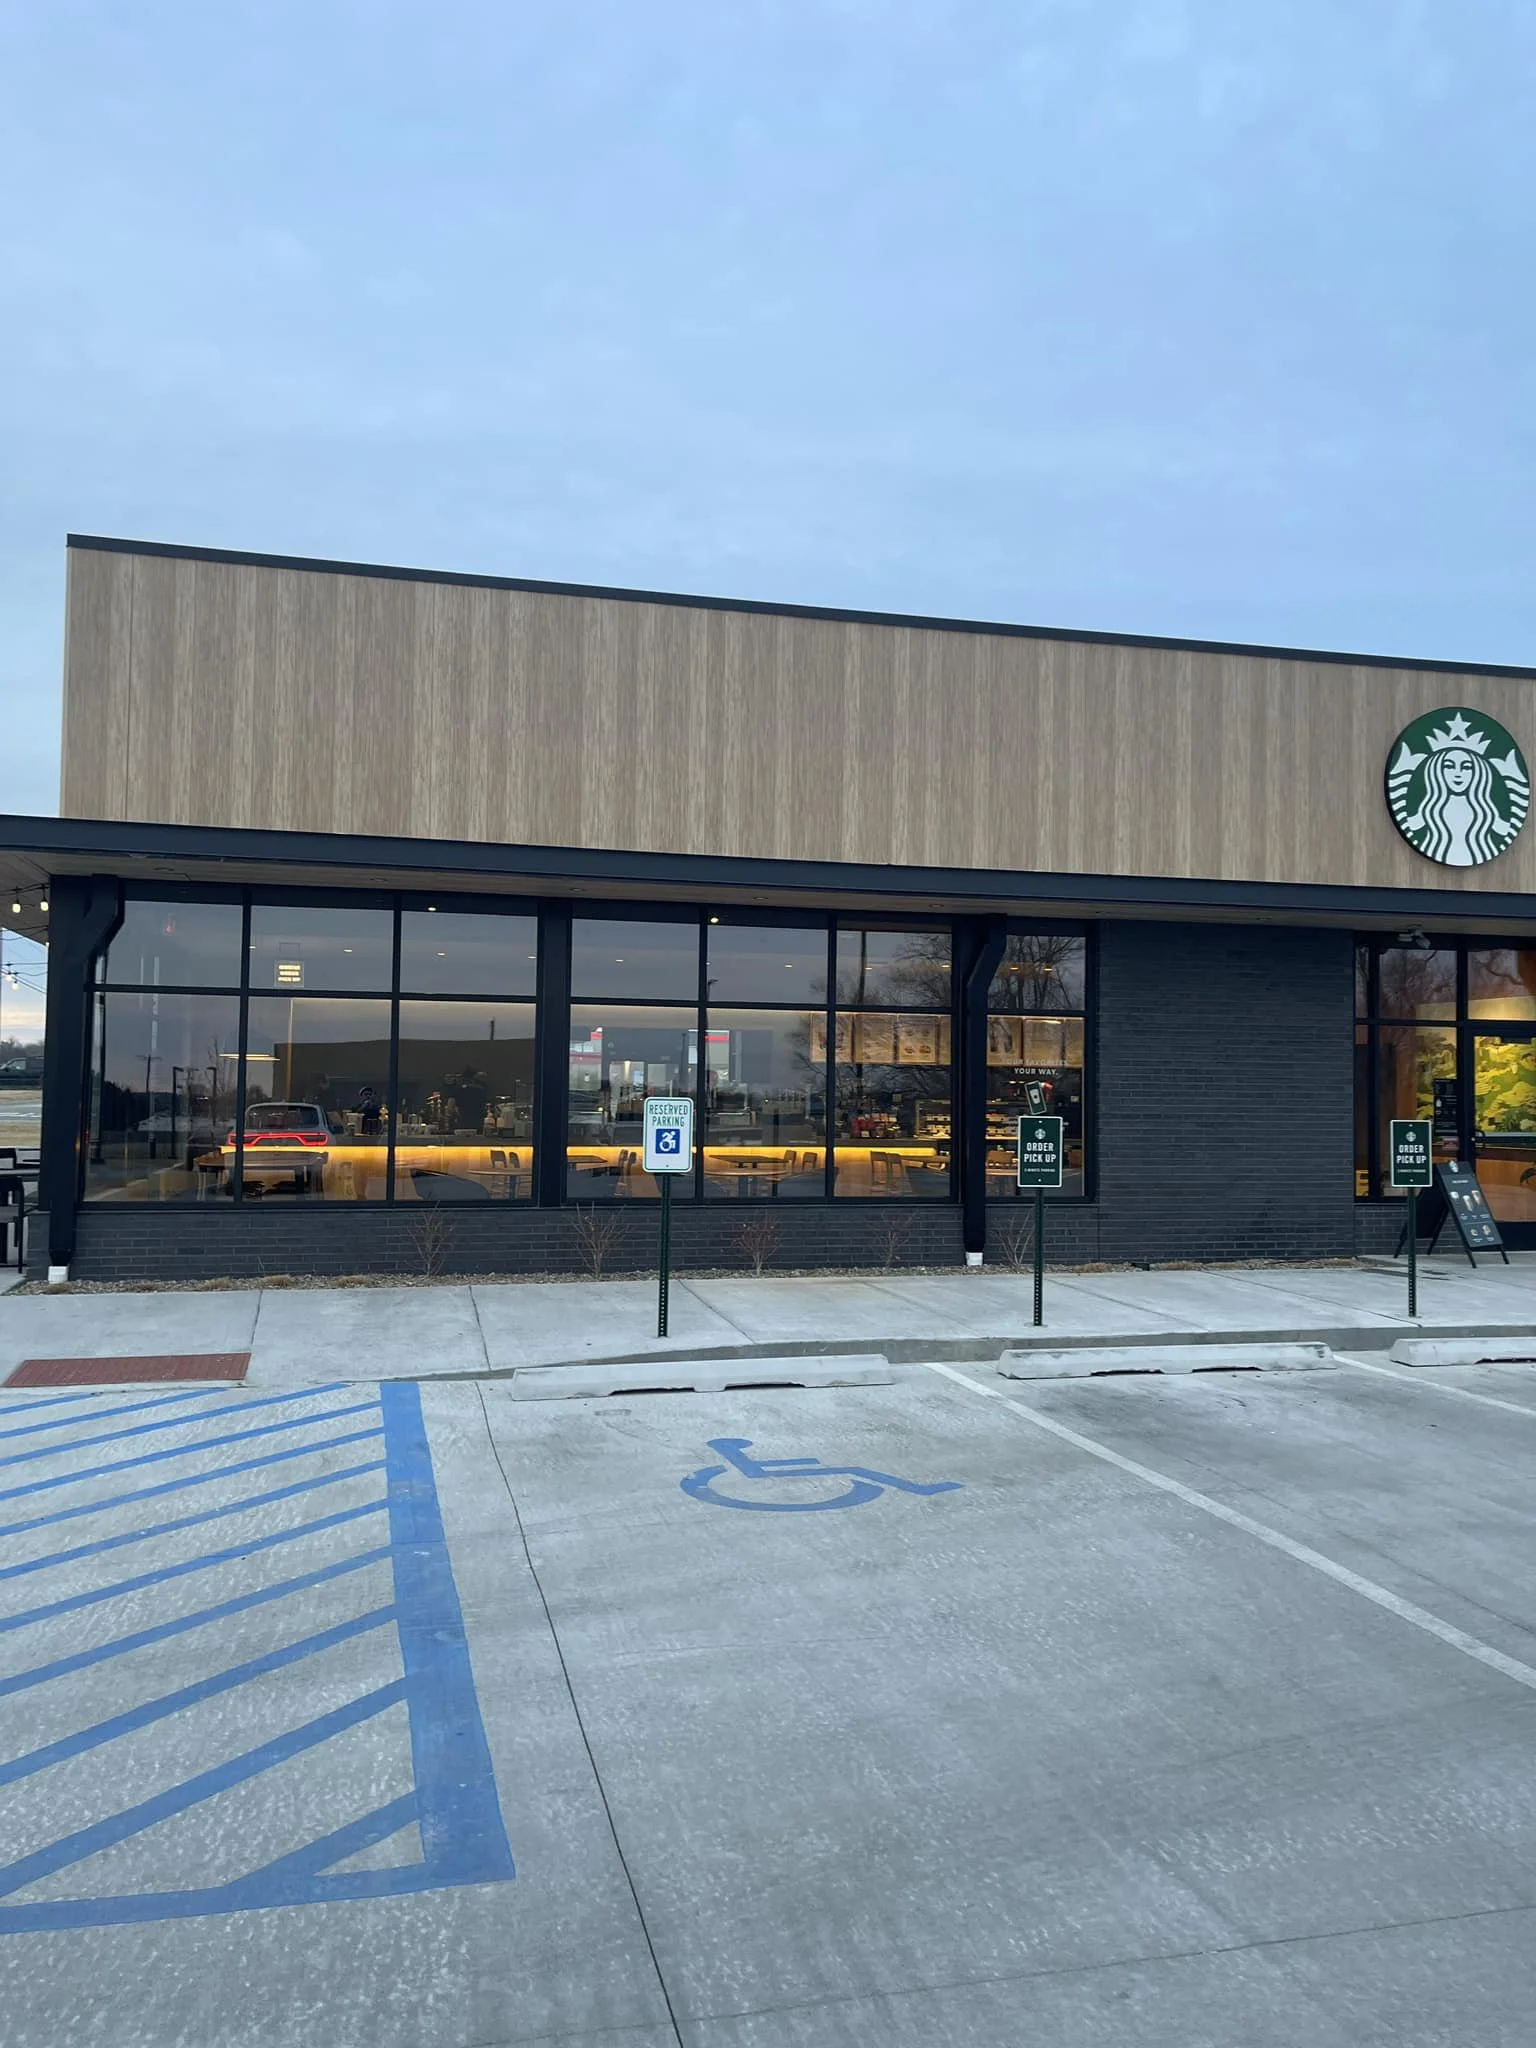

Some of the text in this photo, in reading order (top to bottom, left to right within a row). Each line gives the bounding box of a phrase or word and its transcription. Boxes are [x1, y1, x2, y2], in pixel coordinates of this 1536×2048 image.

[1014, 1067, 1059, 1076] YOUR WAY.
[649, 1104, 689, 1115] RESERVED
[652, 1115, 685, 1127] PARKING
[1026, 1142, 1054, 1152] ORDER
[1398, 1144, 1425, 1154] ORDER
[1023, 1153, 1057, 1163] PICK UP
[1396, 1155, 1427, 1164] PICK UP
